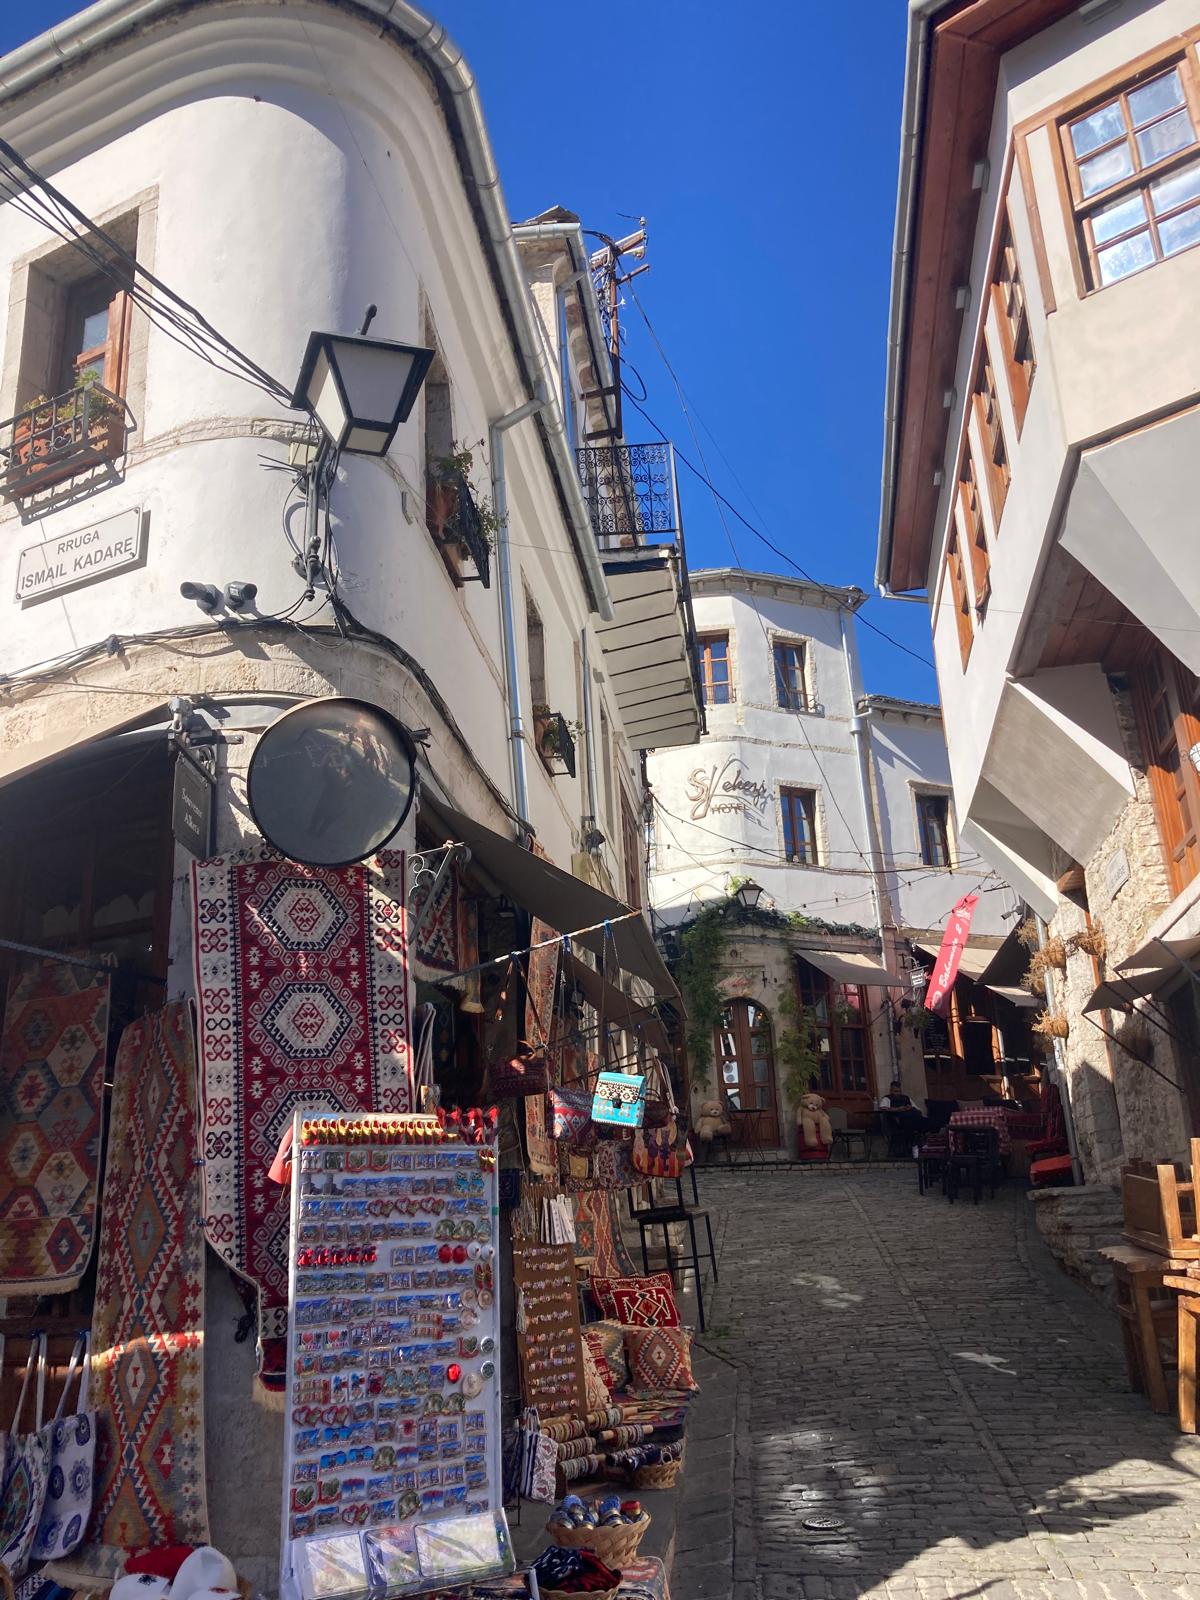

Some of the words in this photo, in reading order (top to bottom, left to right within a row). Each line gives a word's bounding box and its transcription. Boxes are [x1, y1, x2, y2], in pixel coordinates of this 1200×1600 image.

[57, 530, 100, 555] RRUGA
[21, 565, 68, 590] ISMAIL
[73, 537, 133, 571] KADARE
[711, 802, 750, 815] HOTEL
